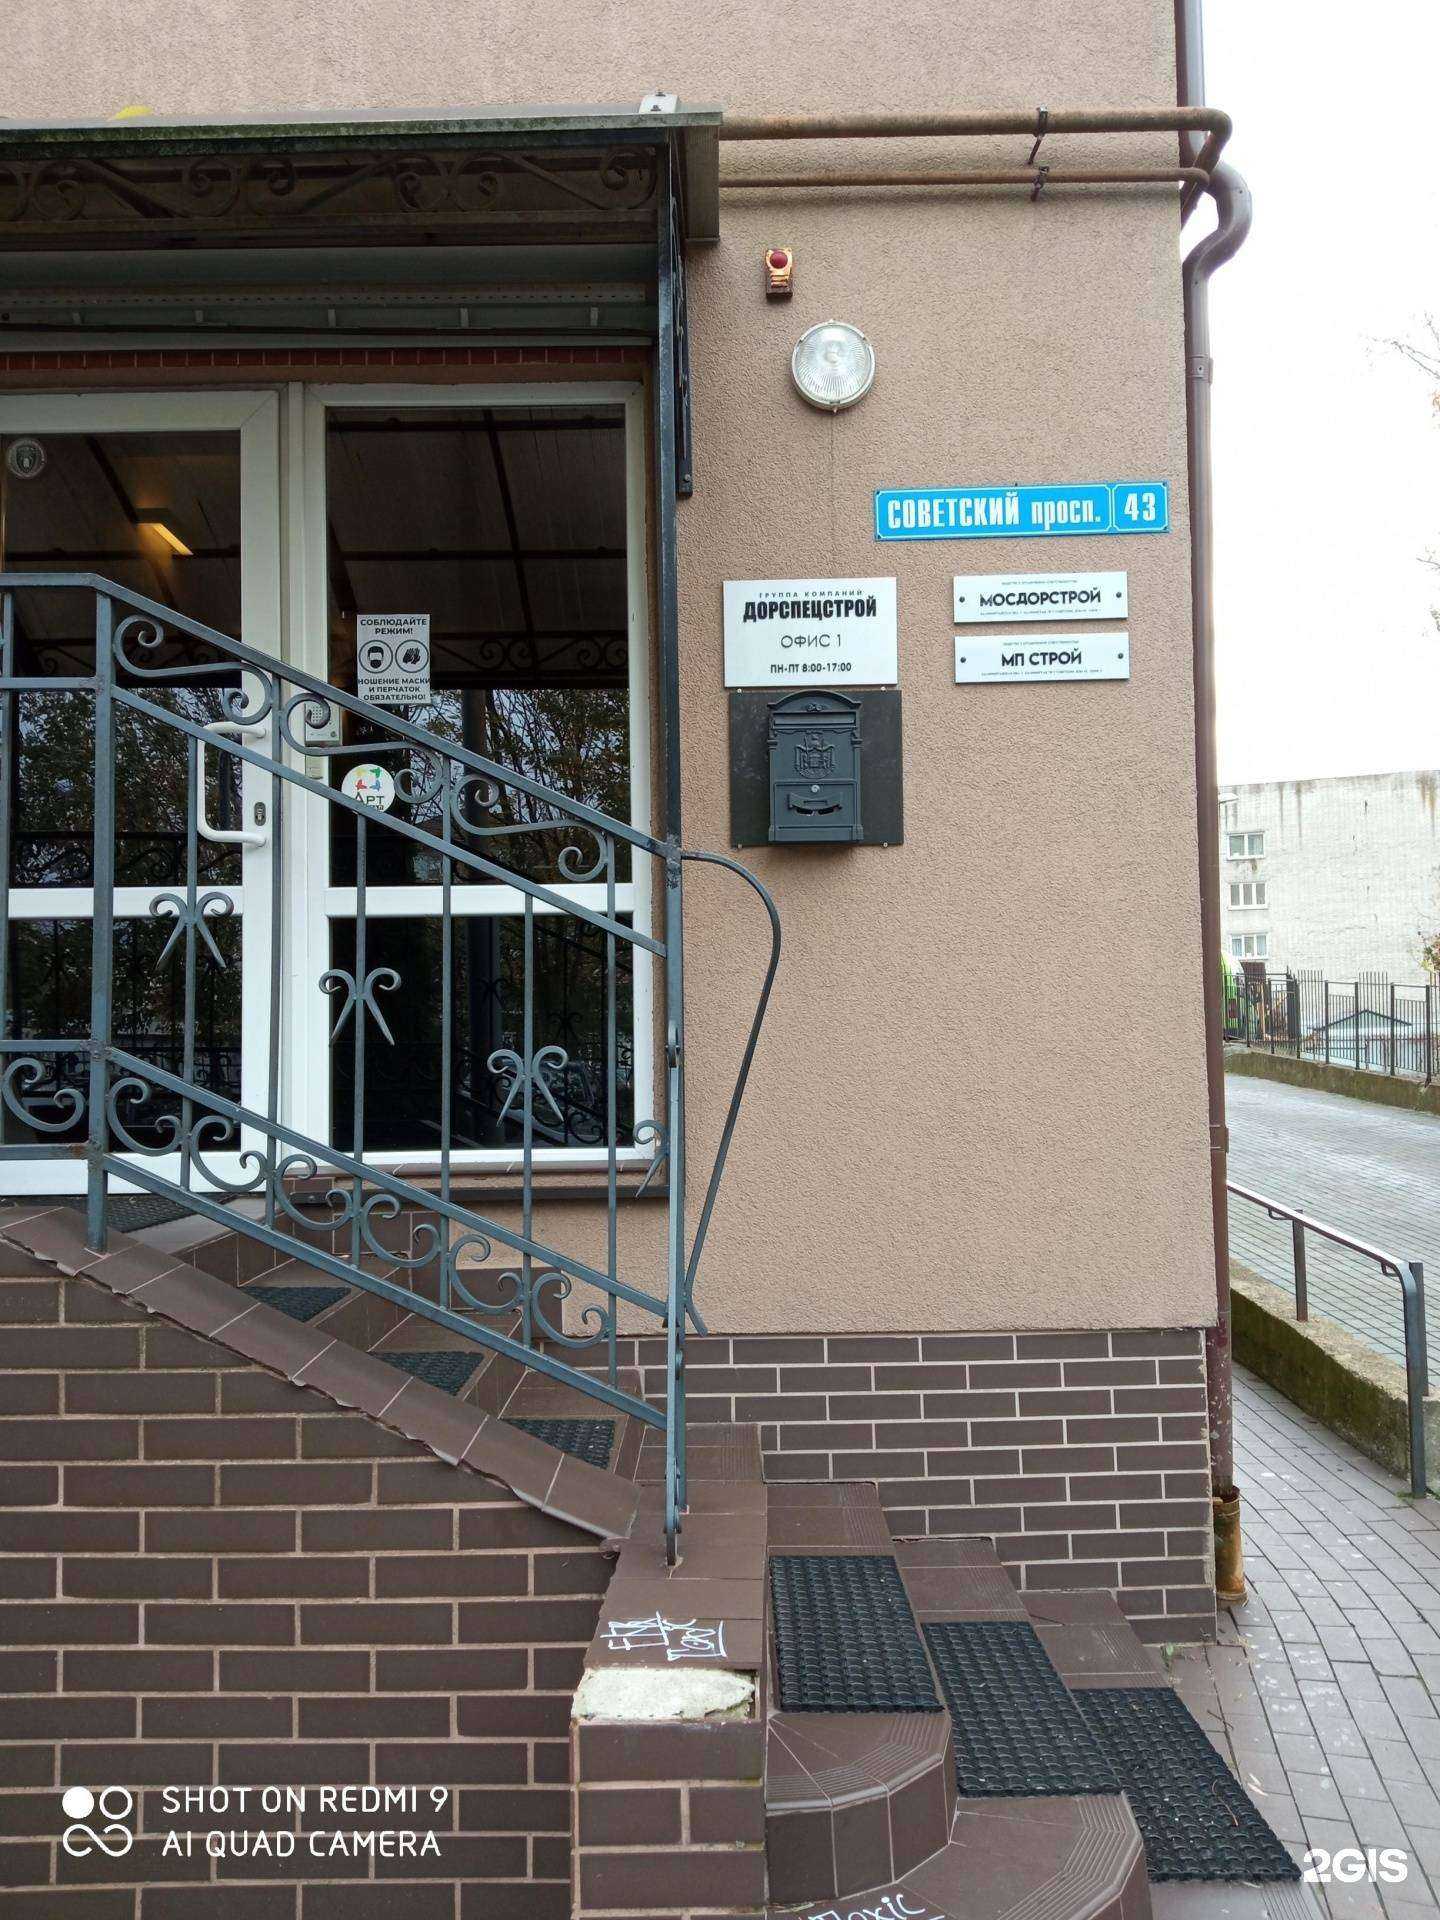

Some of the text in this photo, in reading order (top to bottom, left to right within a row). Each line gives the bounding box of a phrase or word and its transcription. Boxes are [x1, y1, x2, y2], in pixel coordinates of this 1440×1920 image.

[888, 492, 1101, 530] СОВЕТСКИЙ просп.
[1123, 492, 1156, 521] 43
[980, 587, 1101, 607] МОСДОРСТРОЙ
[743, 596, 876, 622] ДОРСПЕЦСТРОЙ
[360, 617, 427, 626] СОБЛЮДАЙТЕ
[375, 627, 413, 635] РЕЖИМ!
[781, 634, 841, 648] ОФИС 1
[1002, 648, 1082, 667] МП СТРОЙ
[770, 662, 852, 674] ПН-ПТ 8:00-17:00
